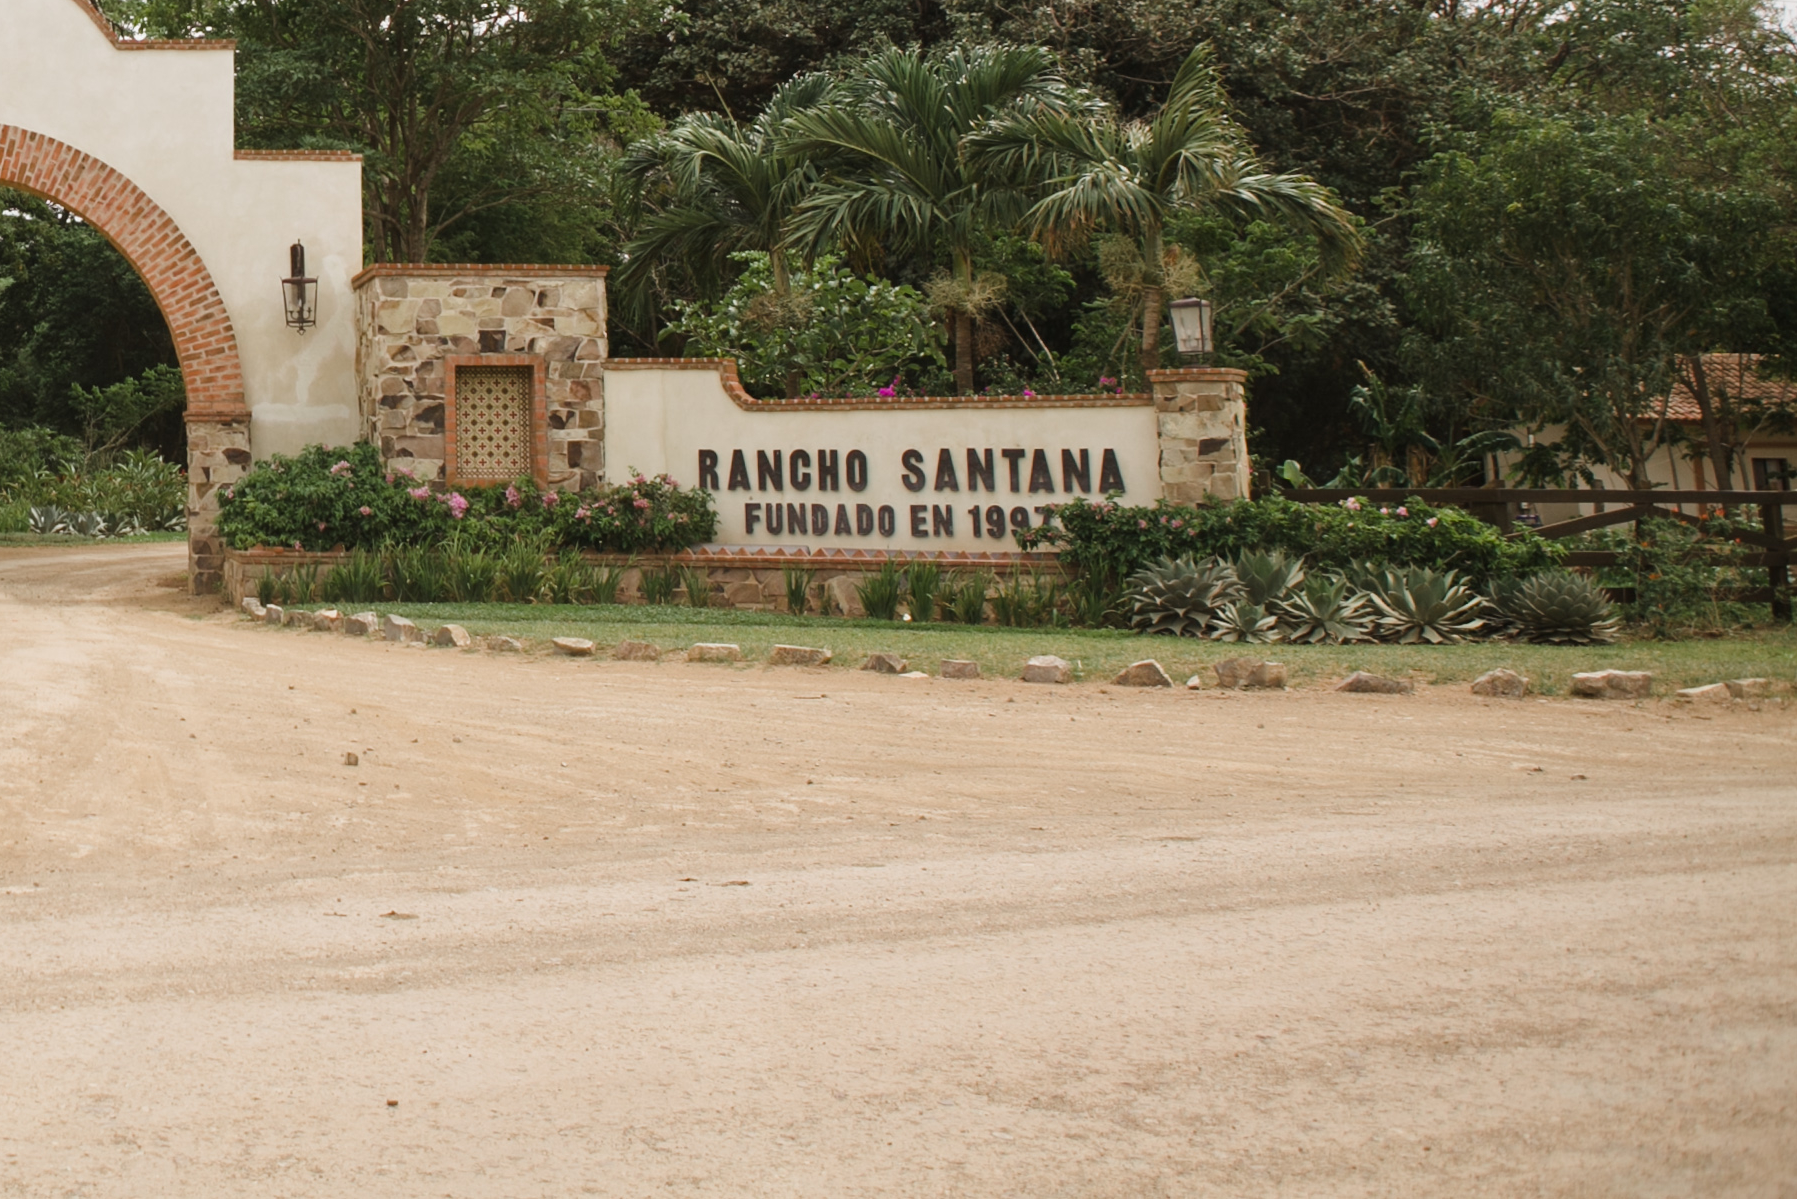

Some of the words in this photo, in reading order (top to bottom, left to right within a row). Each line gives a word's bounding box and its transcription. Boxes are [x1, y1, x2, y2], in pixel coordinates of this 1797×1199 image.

[698, 449, 868, 492] RANCHO
[901, 448, 1125, 493] SANTANA
[745, 503, 895, 537] FUNDADO
[910, 504, 953, 538] EN
